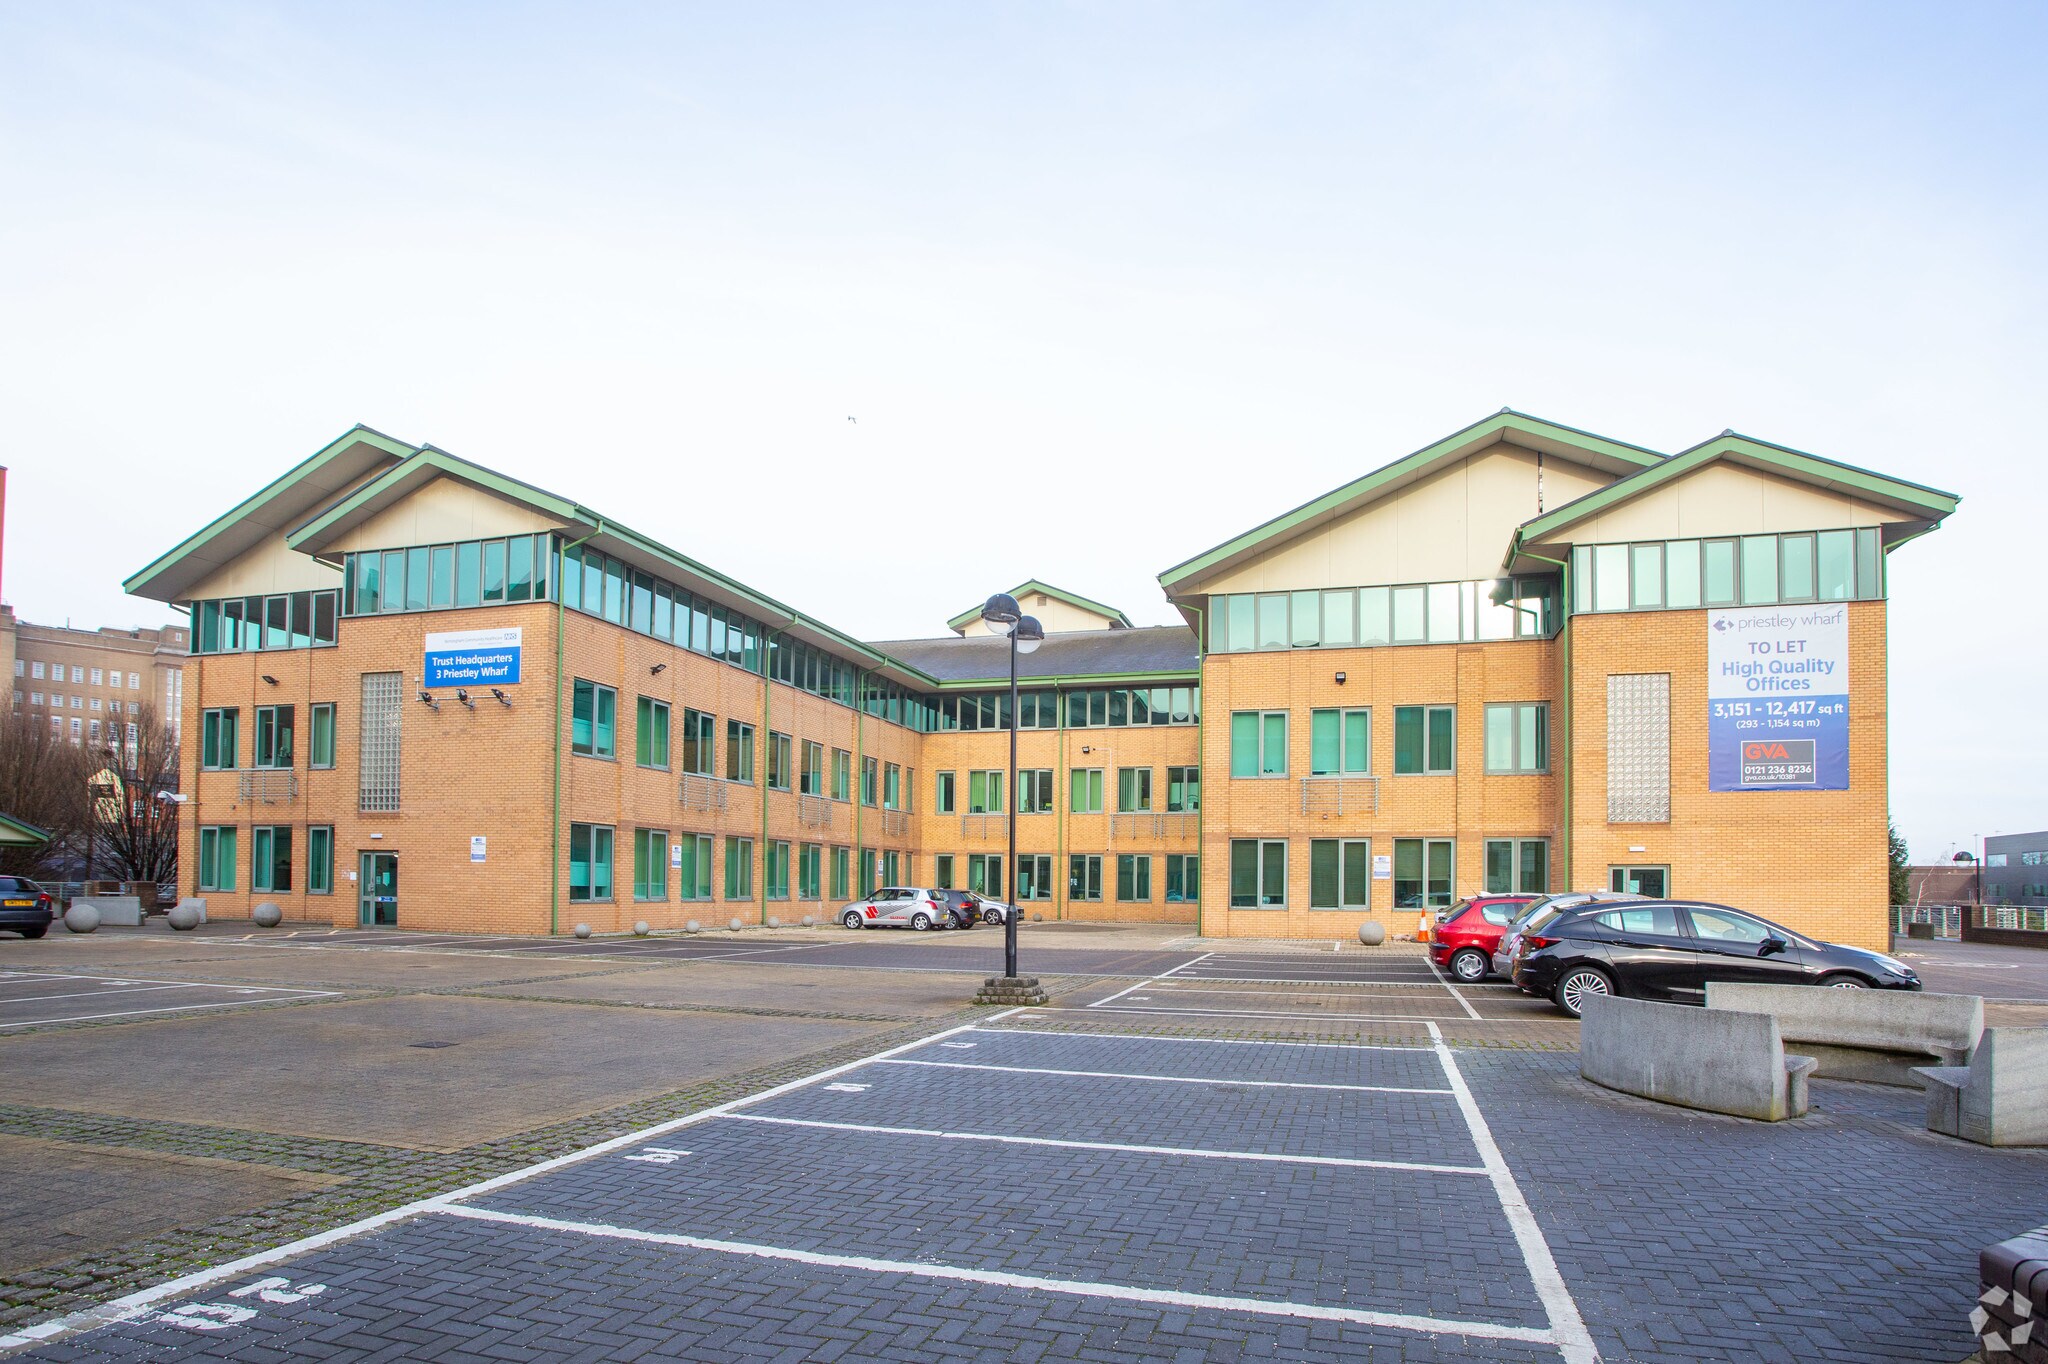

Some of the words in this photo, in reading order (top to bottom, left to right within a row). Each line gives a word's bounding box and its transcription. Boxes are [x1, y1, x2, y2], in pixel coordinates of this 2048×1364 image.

[1738, 614, 1797, 632] priestley
[1801, 611, 1843, 625] wharf
[1748, 641, 1771, 654] TO
[1776, 640, 1807, 653] LET
[432, 656, 454, 666] Trust
[455, 654, 513, 666] Headquarters
[1722, 661, 1763, 678] High
[1769, 658, 1835, 675] Quality
[436, 669, 442, 679] 3
[443, 668, 479, 679] Priestley
[481, 665, 508, 677] Wharf
[1746, 676, 1811, 692] Offices
[1714, 703, 1751, 719] 3,151
[1766, 701, 1816, 717] 12,417
[1818, 705, 1832, 715] sq
[1834, 703, 1844, 714] ft
[1736, 720, 1758, 729] (293
[1767, 719, 1790, 728] 1,154
[1792, 720, 1804, 728] sq
[1806, 718, 1821, 728] m)
[1745, 743, 1790, 760] GVA
[1744, 766, 1766, 774] 0121
[1767, 765, 1786, 774] 236
[1787, 765, 1812, 774] 8236
[624, 1147, 693, 1164] 19
